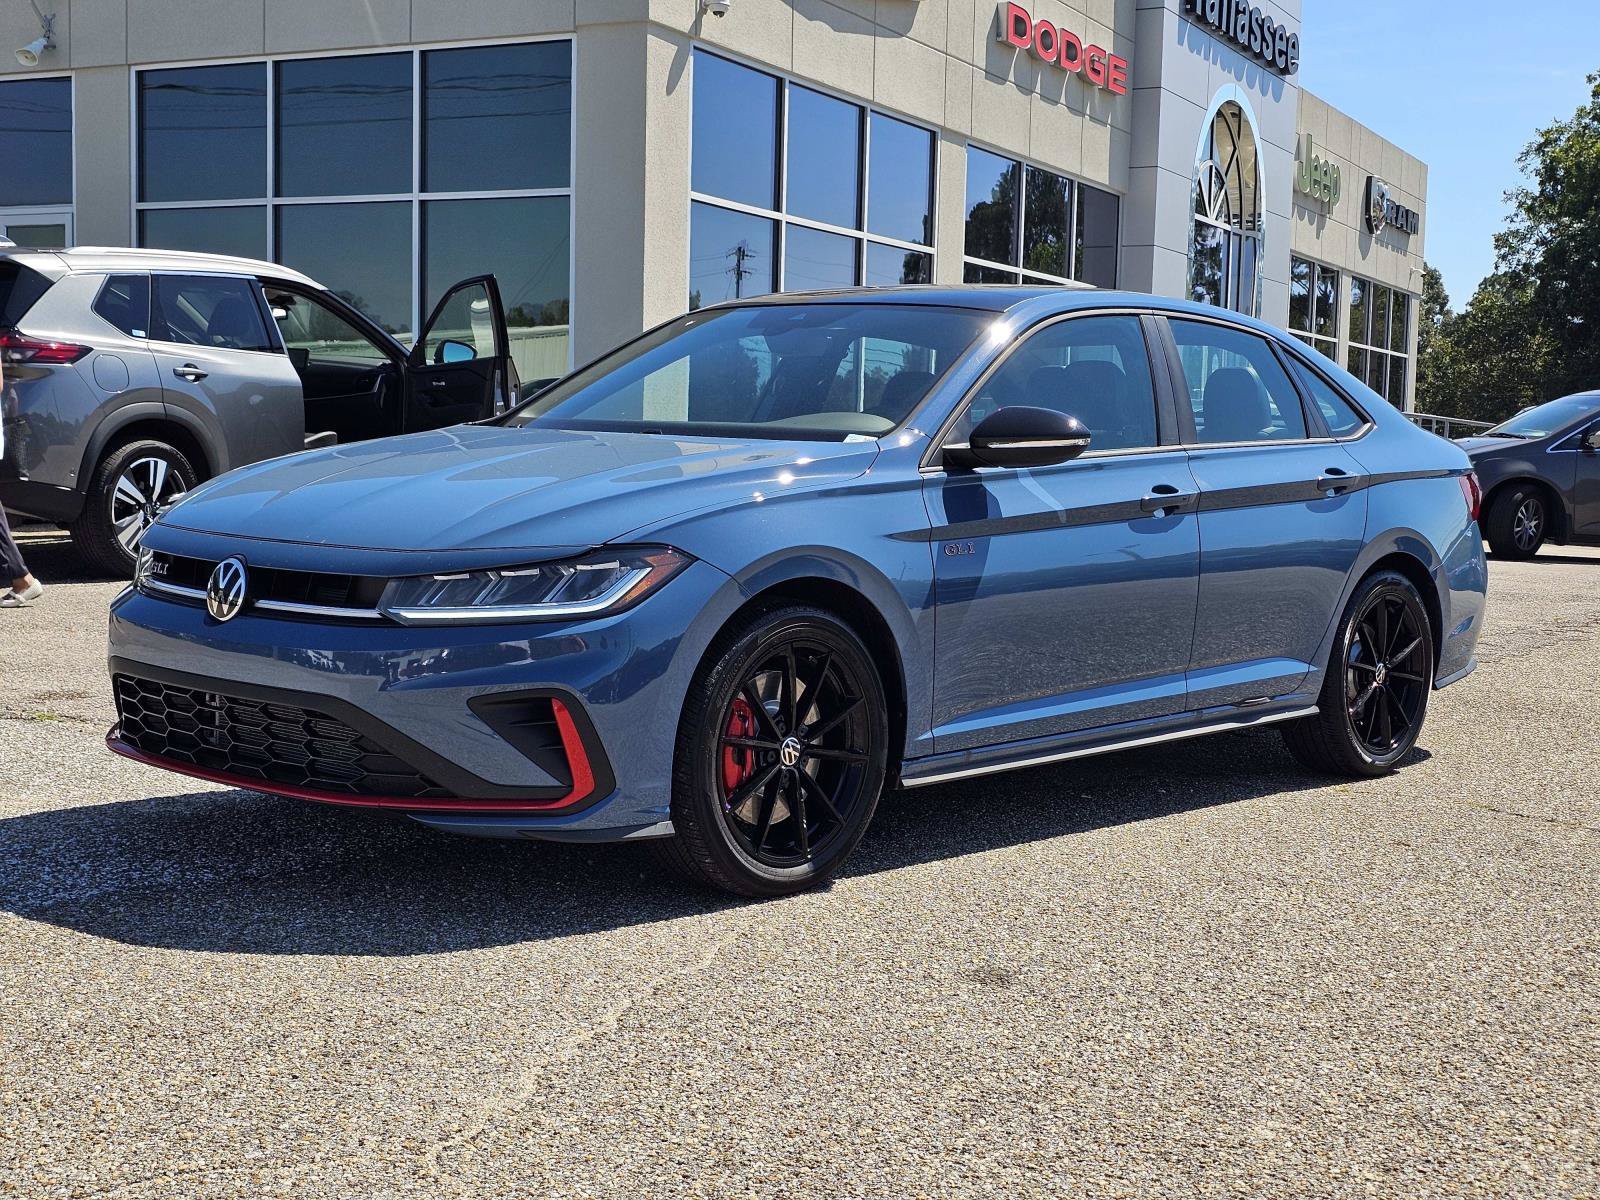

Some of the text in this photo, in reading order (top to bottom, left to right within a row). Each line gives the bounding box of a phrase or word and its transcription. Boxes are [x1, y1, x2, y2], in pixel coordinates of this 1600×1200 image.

[1007, 1, 1128, 96] DODGE
[1194, 0, 1300, 75] allassee
[1297, 133, 1341, 214] Jeep
[1385, 198, 1420, 235] RAM
